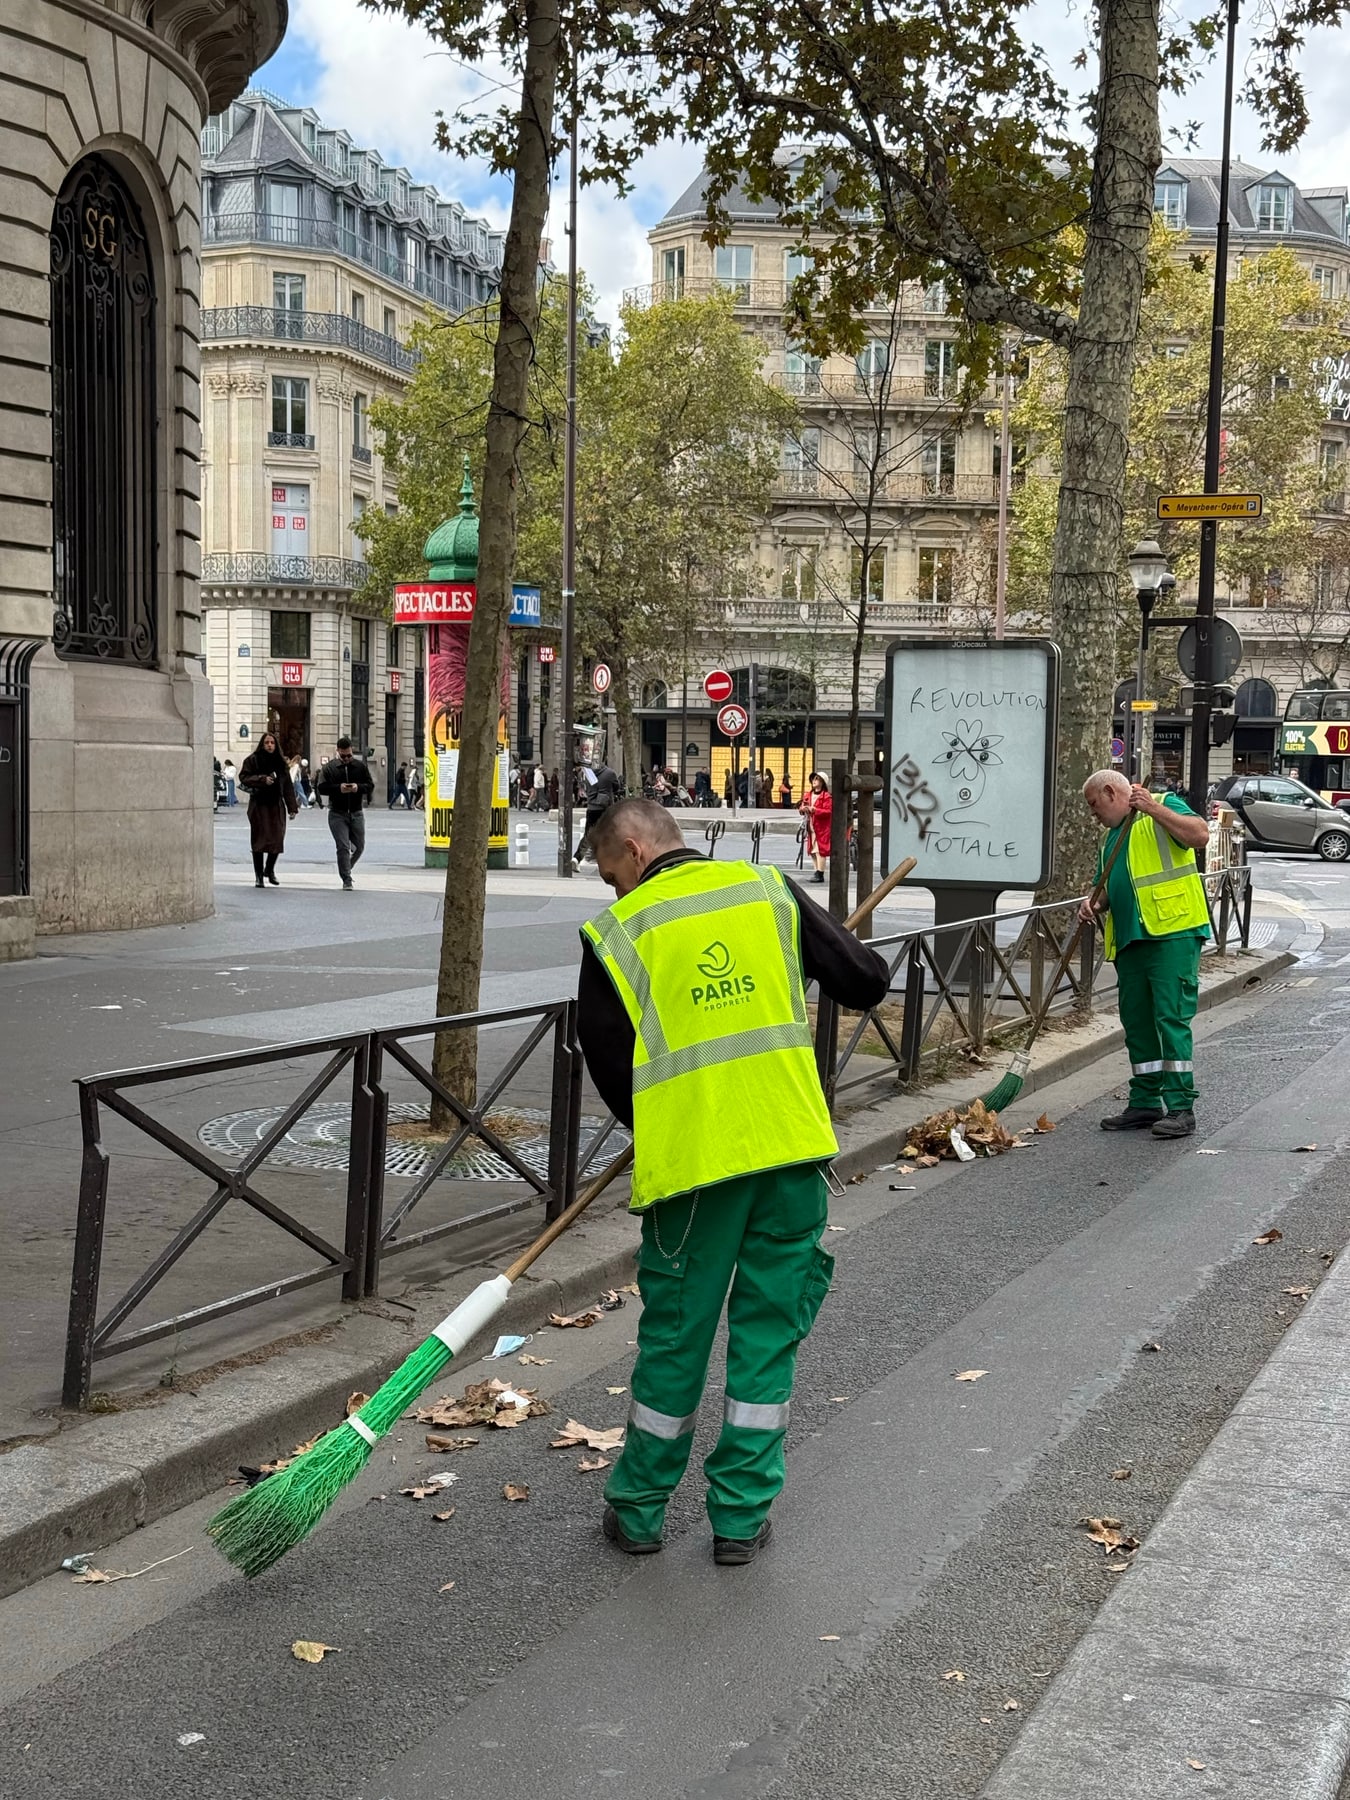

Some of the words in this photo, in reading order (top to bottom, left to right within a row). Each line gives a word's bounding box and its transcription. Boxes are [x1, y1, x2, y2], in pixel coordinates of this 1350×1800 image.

[1176, 502, 1244, 512] Meyerbeer-Opéra
[395, 591, 473, 613] SPECTACLES
[284, 665, 299, 674] UNI
[284, 674, 301, 683] QLO
[1285, 730, 1306, 744] 100%
[1284, 743, 1306, 751] ELECTRIC
[923, 831, 1019, 858] TOTALE
[690, 974, 756, 1006] PARIS
